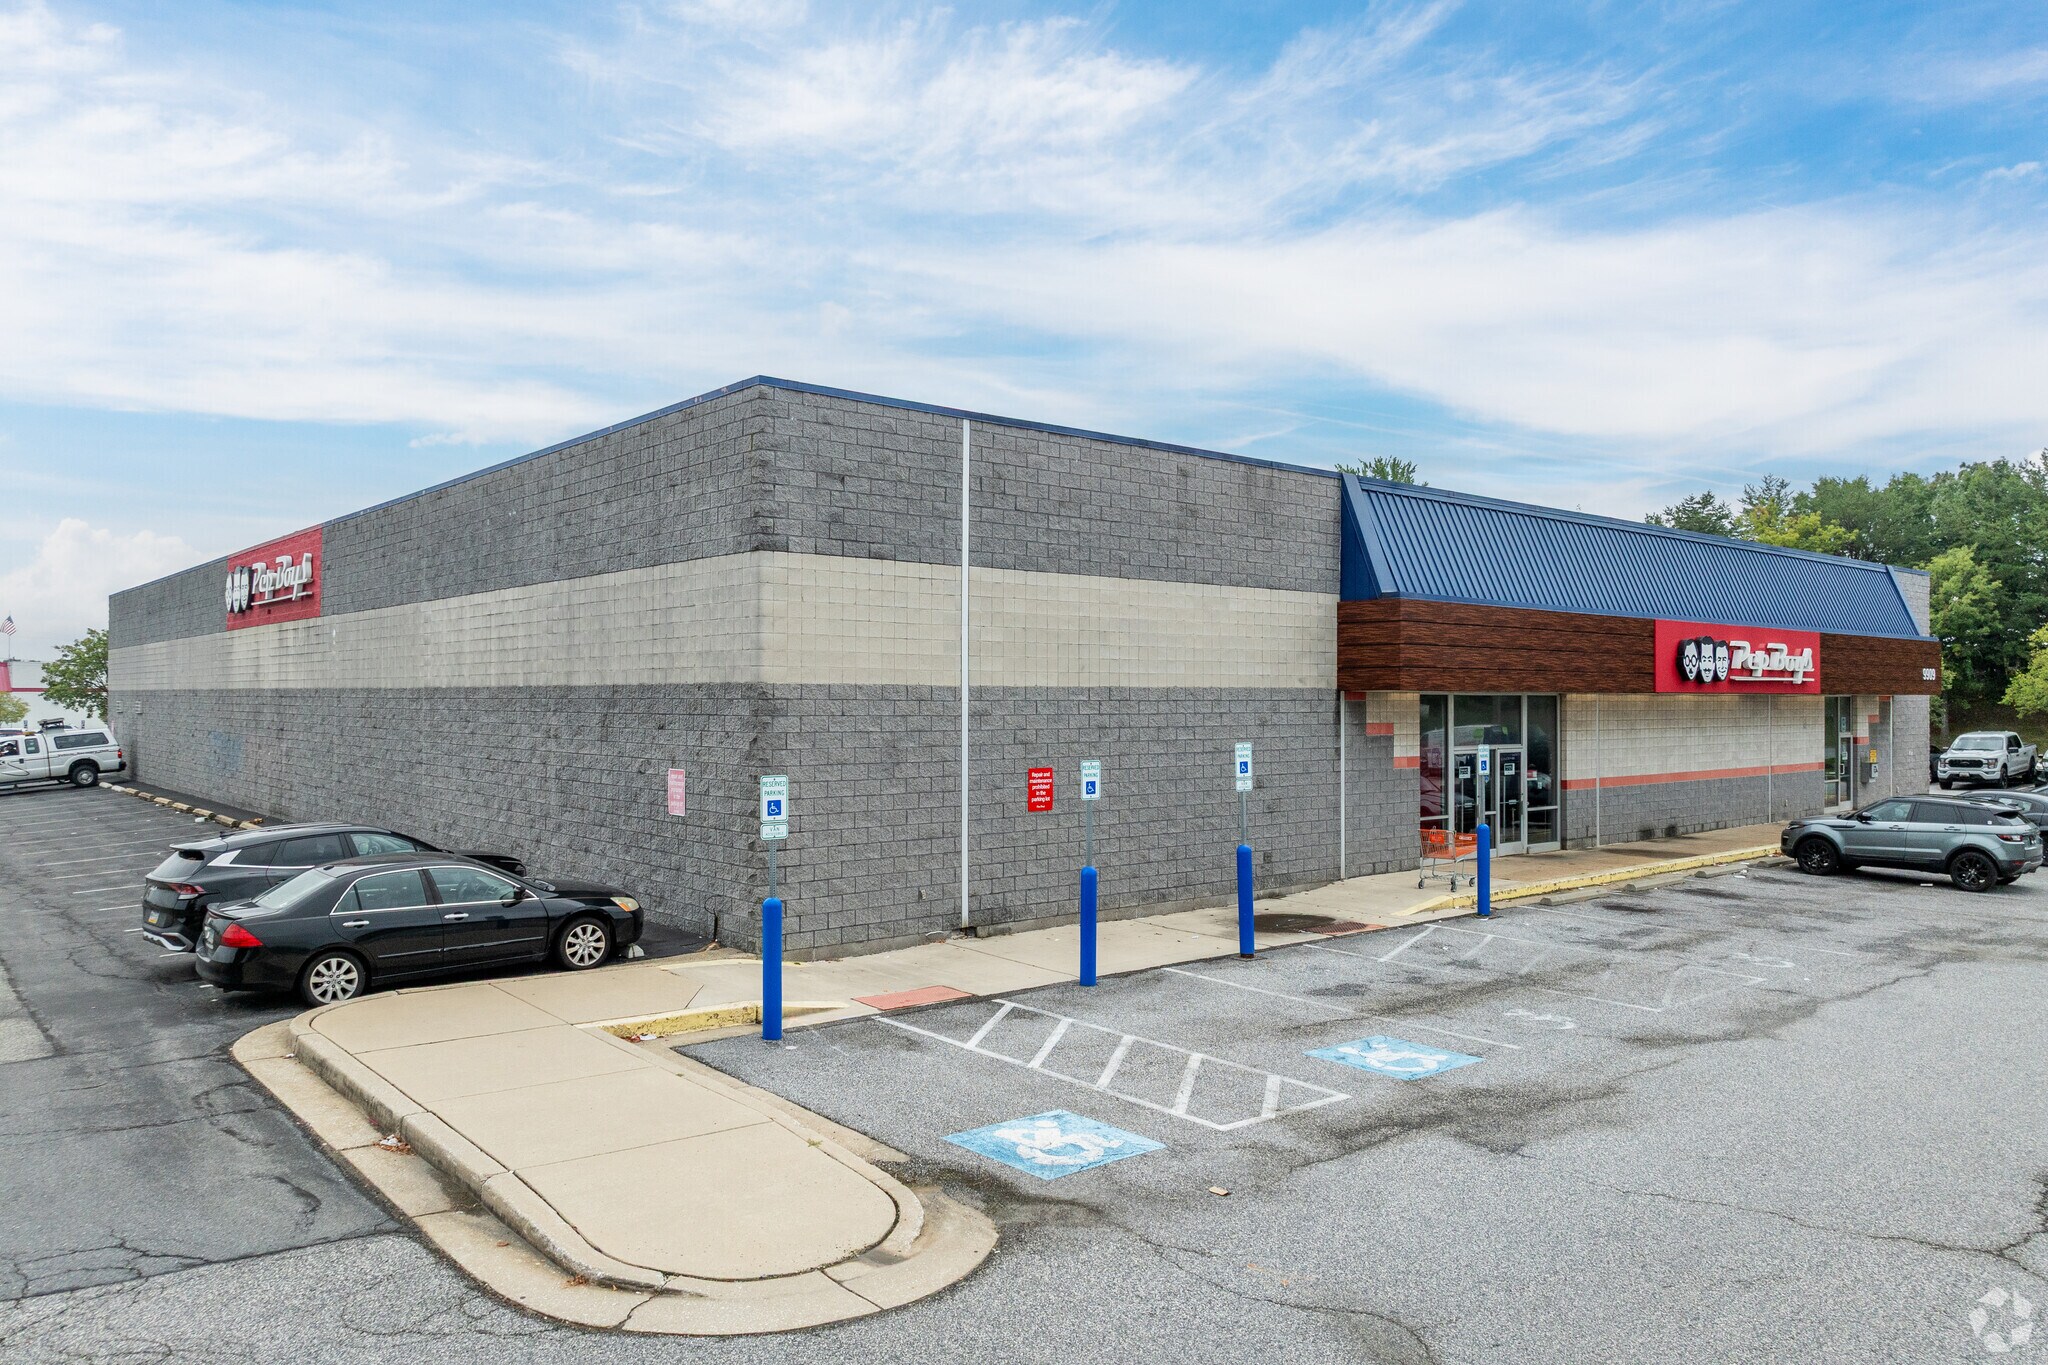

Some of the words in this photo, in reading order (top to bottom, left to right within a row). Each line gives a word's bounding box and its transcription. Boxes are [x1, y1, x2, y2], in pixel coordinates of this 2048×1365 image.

[252, 562, 277, 600] Pep
[275, 553, 313, 601] Boys
[1729, 640, 1769, 677] Pep
[1766, 642, 1815, 684] Boys
